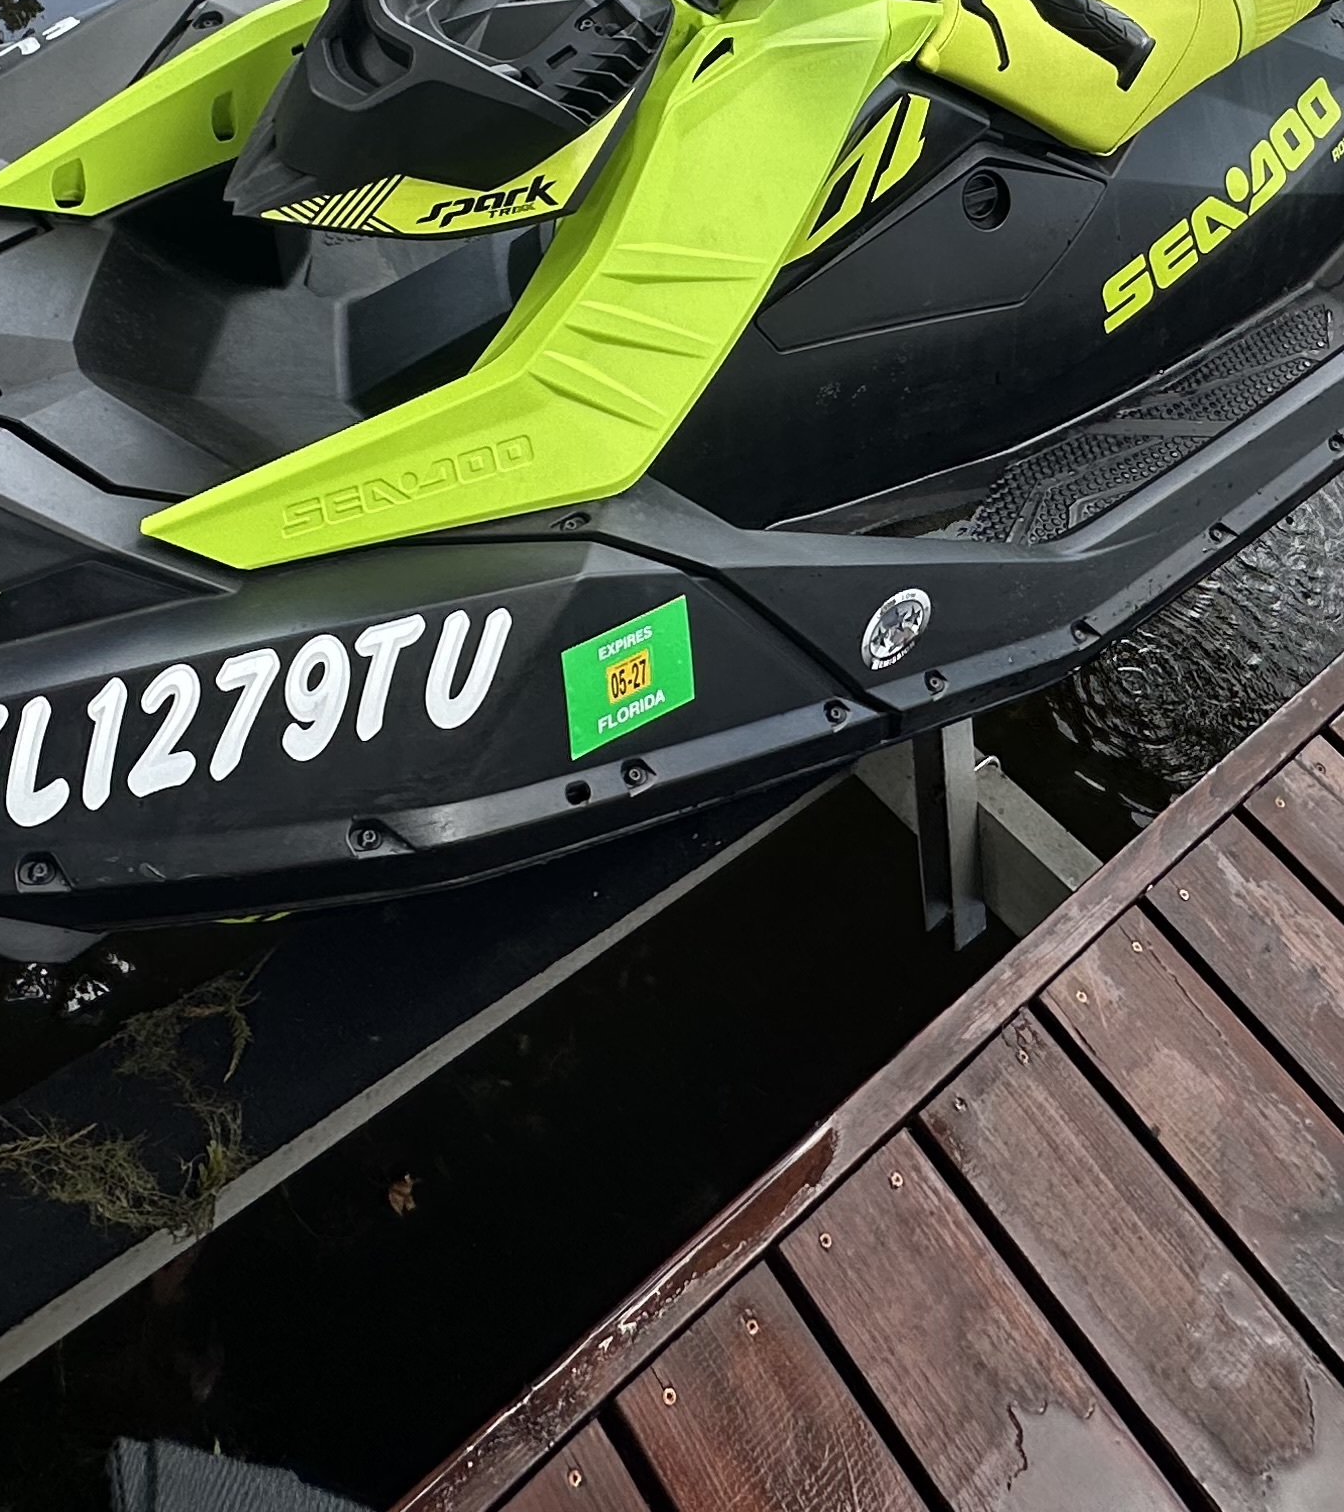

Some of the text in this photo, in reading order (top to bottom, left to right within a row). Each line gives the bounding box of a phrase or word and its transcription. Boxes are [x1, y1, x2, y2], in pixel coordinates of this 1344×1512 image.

[597, 625, 653, 661] EXPIRES
[610, 659, 647, 699] 05-27
[597, 689, 666, 735] FLORIDA
